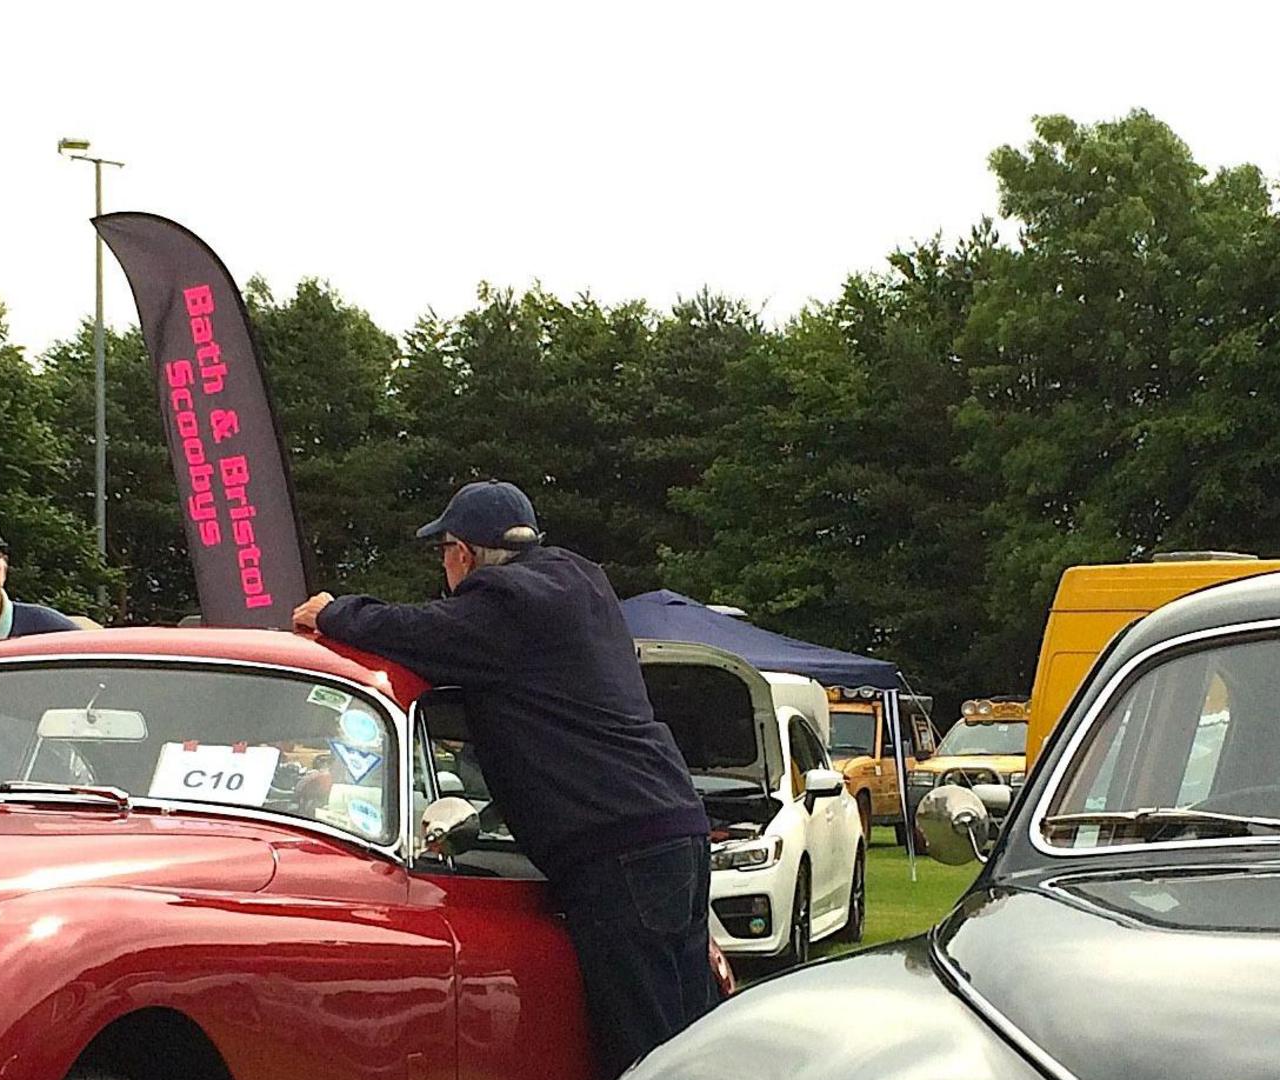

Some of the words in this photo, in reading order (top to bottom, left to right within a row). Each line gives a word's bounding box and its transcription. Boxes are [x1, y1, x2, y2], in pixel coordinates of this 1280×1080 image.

[183, 284, 229, 395] Bath
[164, 359, 222, 547] Scoobys
[209, 409, 240, 445] &
[219, 454, 273, 609] Bristol
[183, 769, 245, 791] C10
